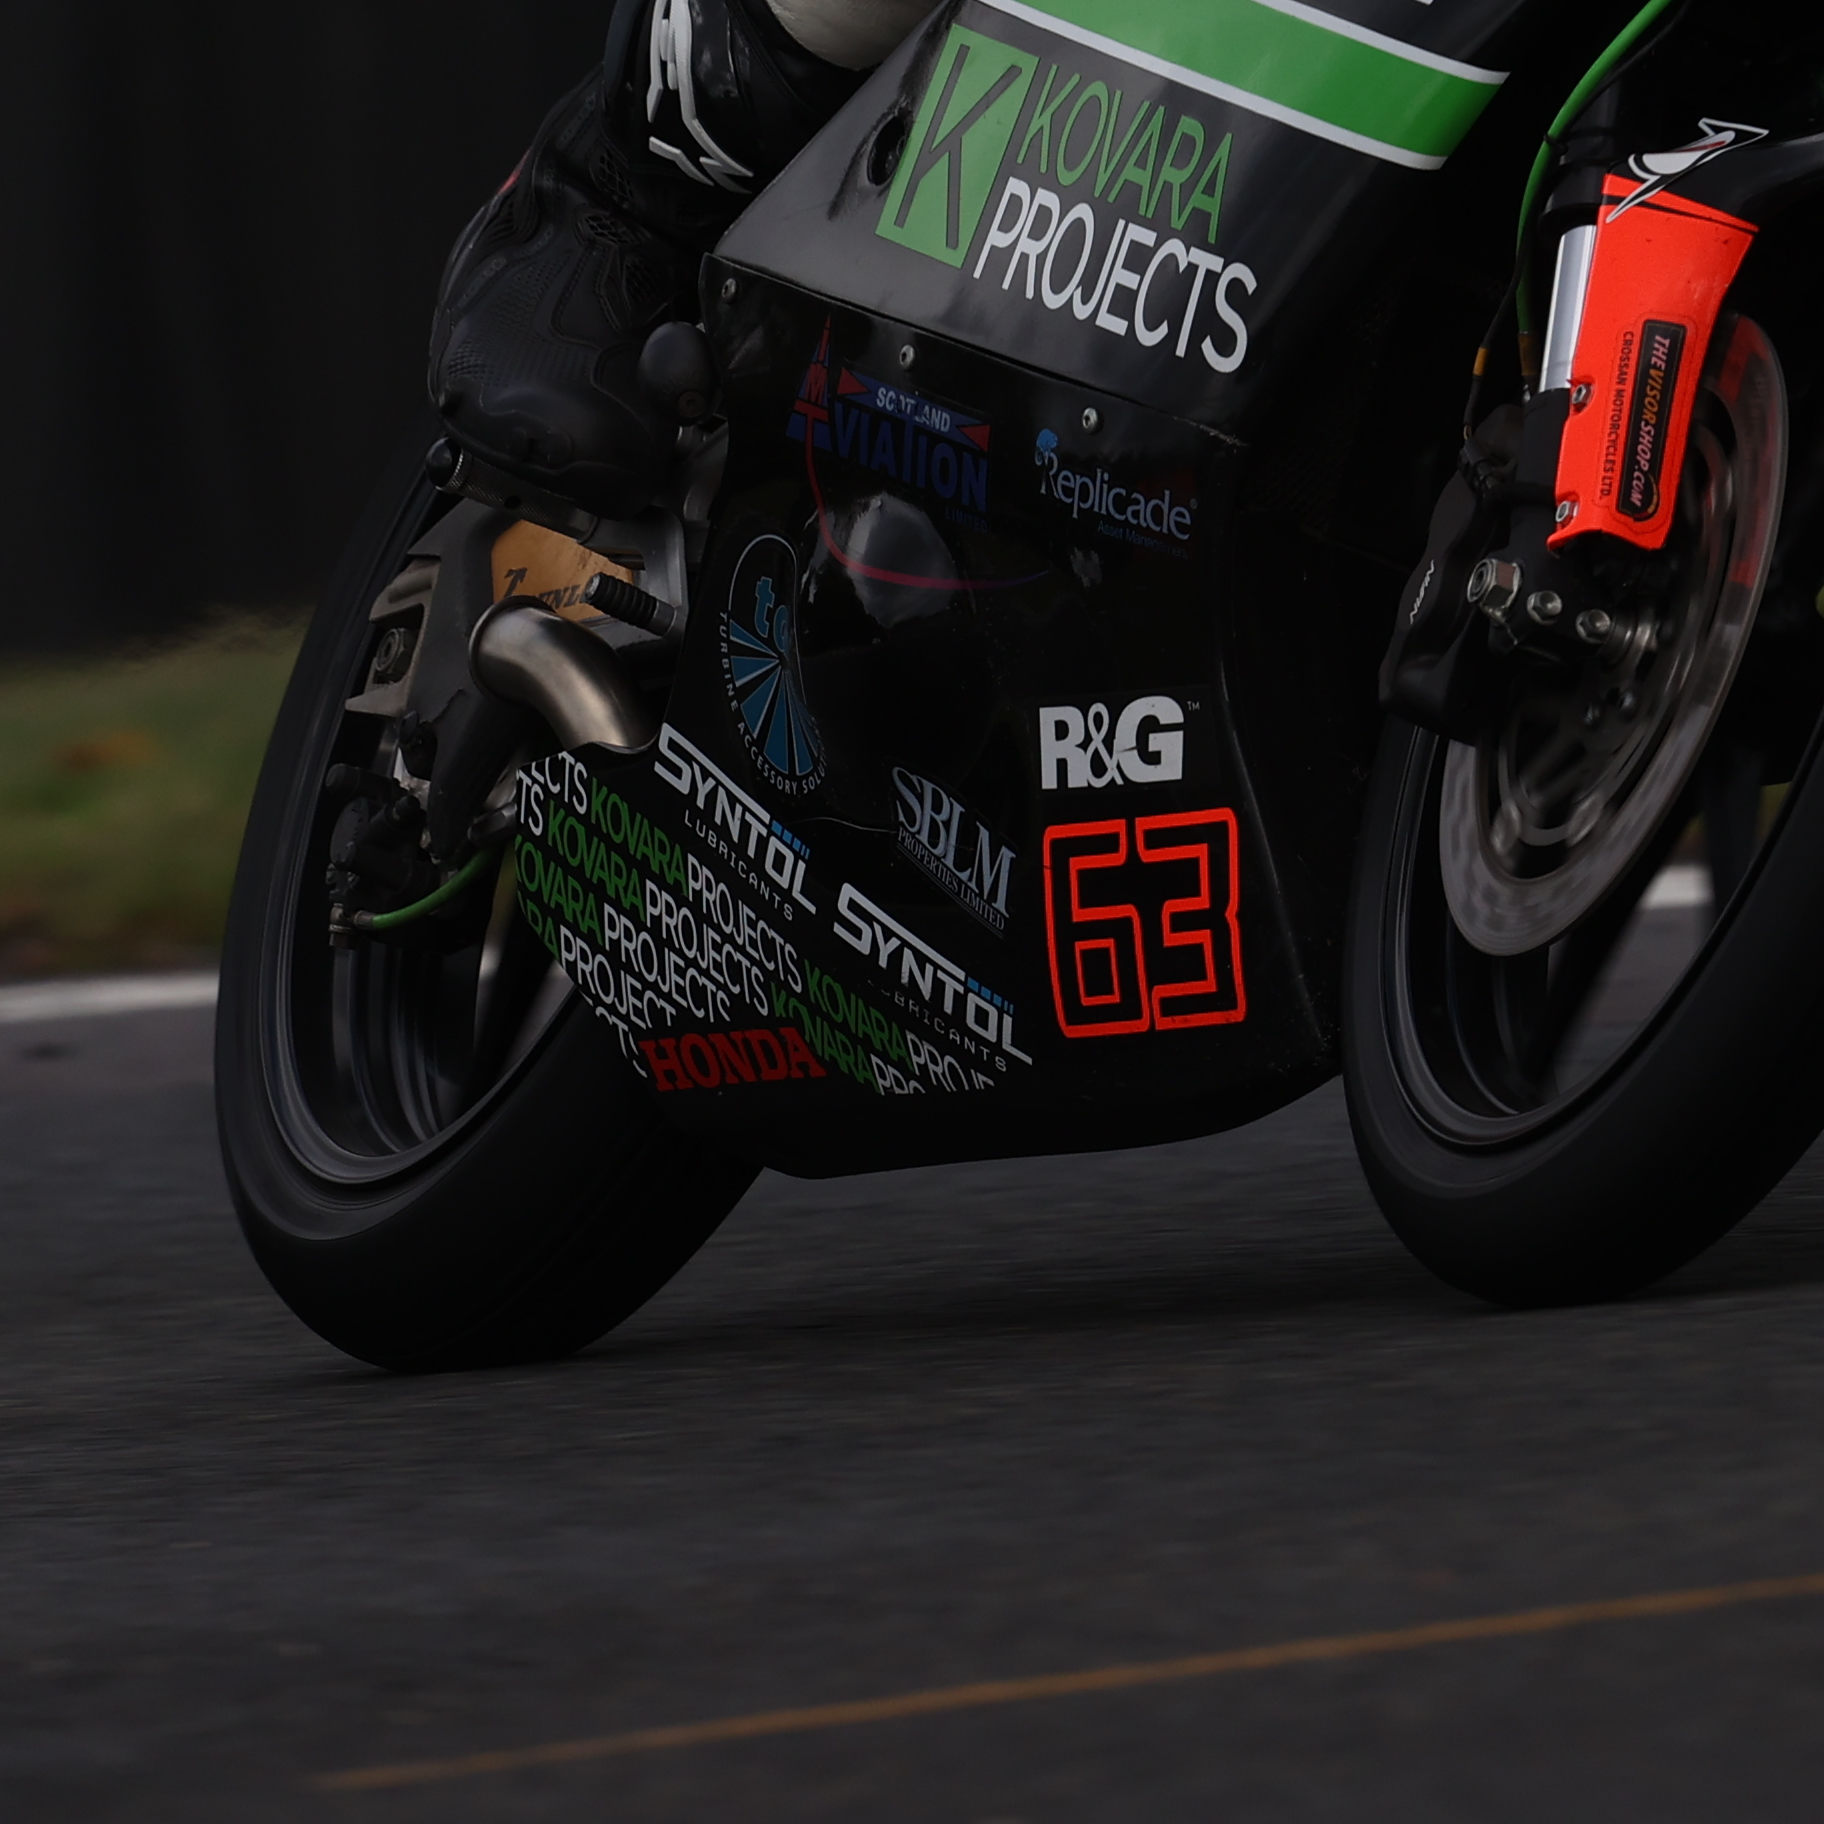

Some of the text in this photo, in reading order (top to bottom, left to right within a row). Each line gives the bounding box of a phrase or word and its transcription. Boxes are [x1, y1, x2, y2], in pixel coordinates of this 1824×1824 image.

[1017, 63, 1234, 244] KOVARA
[973, 176, 1258, 374] PROJECTS
[1034, 448, 1193, 541] Replicade
[1604, 389, 1625, 473] MOTORCYCLES
[1629, 334, 1671, 508] THEVISORSHOP.COM
[654, 722, 817, 915] SYNTOL
[737, 720, 798, 797] ACCESSORY
[1039, 695, 1185, 790] R&G
[547, 799, 647, 923] KOVARA
[645, 878, 769, 1017] PROJECTS
[684, 808, 794, 922] LUBRICANTS
[891, 766, 1017, 918] SBLM
[898, 826, 1005, 931] PROPERTIES LIMITED
[591, 776, 688, 897] KOVARA
[687, 852, 803, 994] PROJECTS
[804, 958, 915, 1072] KOVARA
[833, 882, 1033, 1066] SYNTOL
[1042, 807, 1248, 1038] 63
[638, 1026, 828, 1093] HONDA
[867, 978, 1007, 1073] BRICANTS
